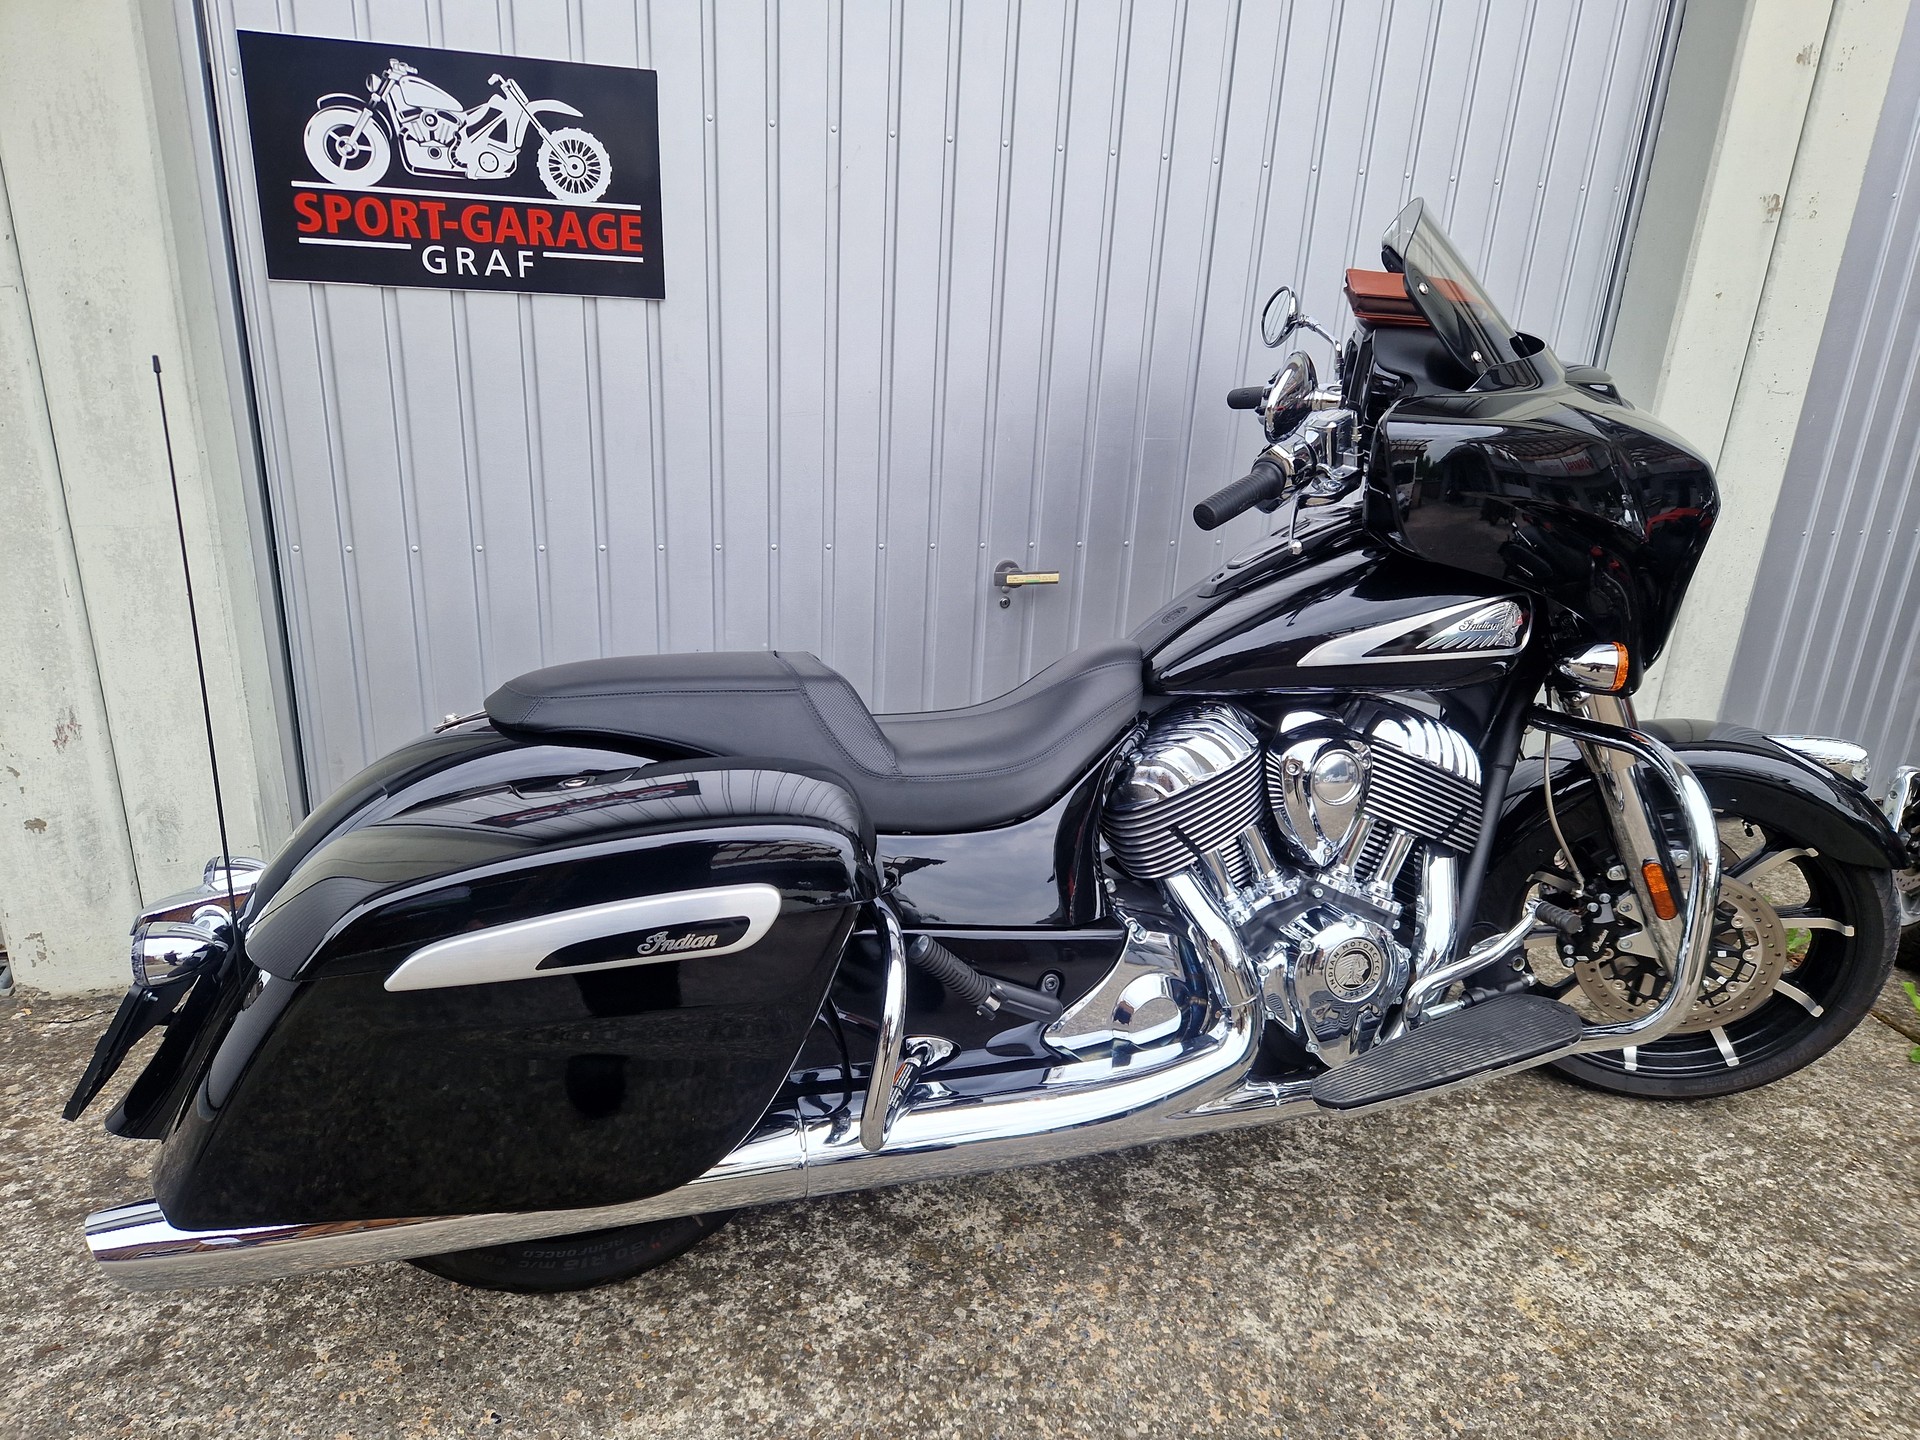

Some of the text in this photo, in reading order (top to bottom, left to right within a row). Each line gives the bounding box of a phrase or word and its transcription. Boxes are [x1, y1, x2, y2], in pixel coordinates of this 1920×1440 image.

[293, 192, 644, 252] SPORT-GARAGE
[421, 245, 535, 279] GRAF
[1459, 619, 1500, 632] Indian
[637, 931, 718, 955] Indian
[1328, 941, 1380, 989] INDIAN MOTORCYCLE
